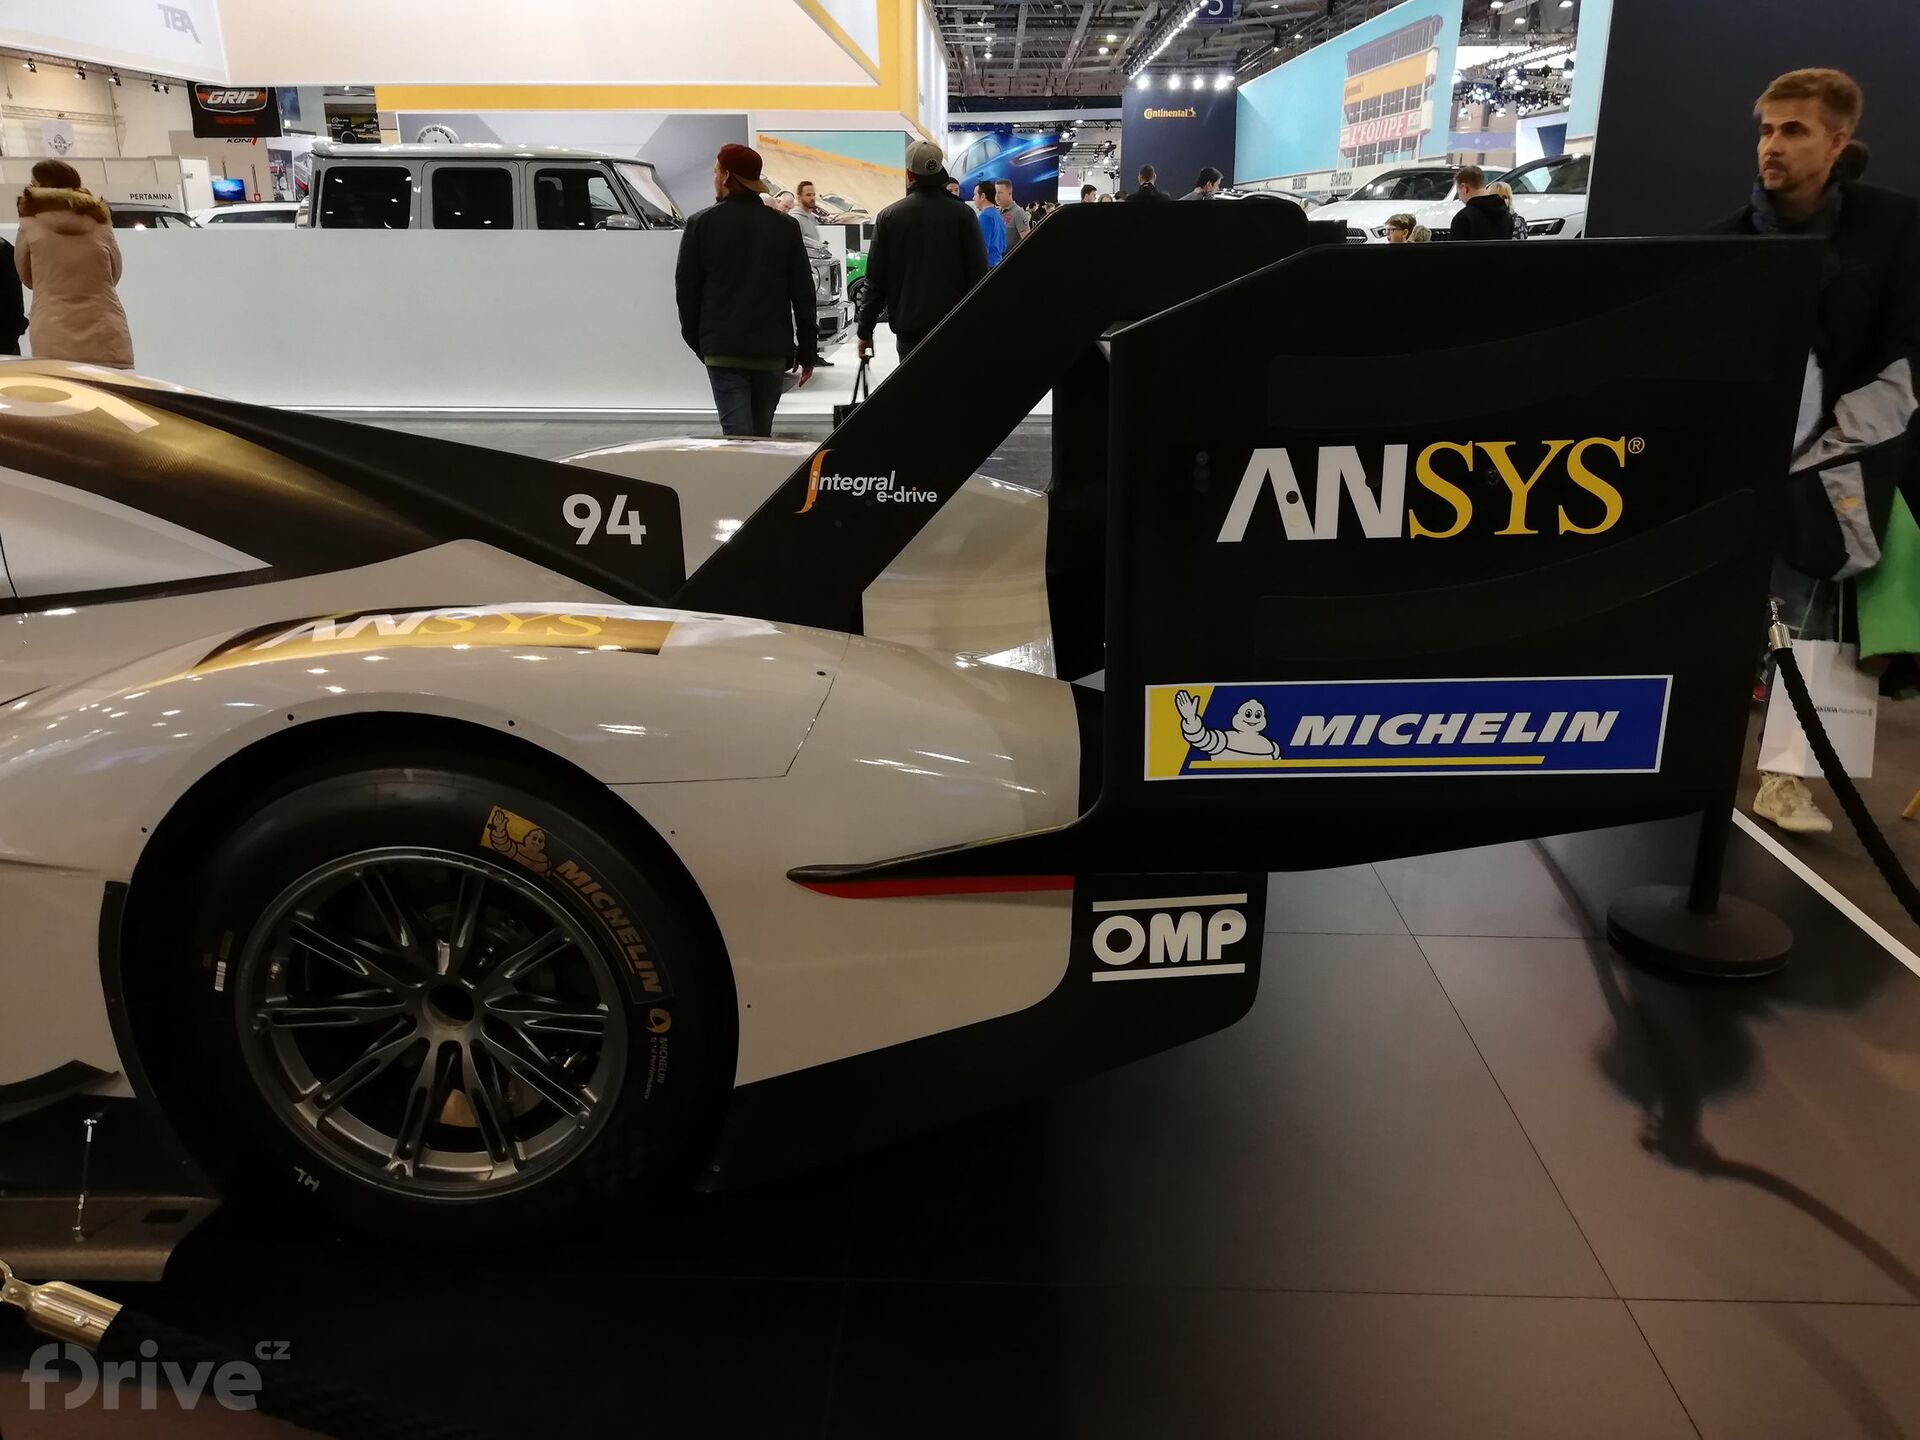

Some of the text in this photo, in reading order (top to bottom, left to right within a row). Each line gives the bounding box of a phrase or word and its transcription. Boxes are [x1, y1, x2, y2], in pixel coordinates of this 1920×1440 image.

[207, 91, 260, 104] GRIP
[1144, 107, 1189, 120] Continental
[129, 193, 173, 201] PERTAMINA
[810, 459, 896, 497] integral
[876, 485, 938, 503] e-drive
[562, 493, 647, 545] 94
[251, 611, 608, 651] ANSYS
[1289, 710, 1621, 747] MICHELIN
[554, 858, 664, 994] MICHELIN
[1092, 908, 1248, 966] OMP
